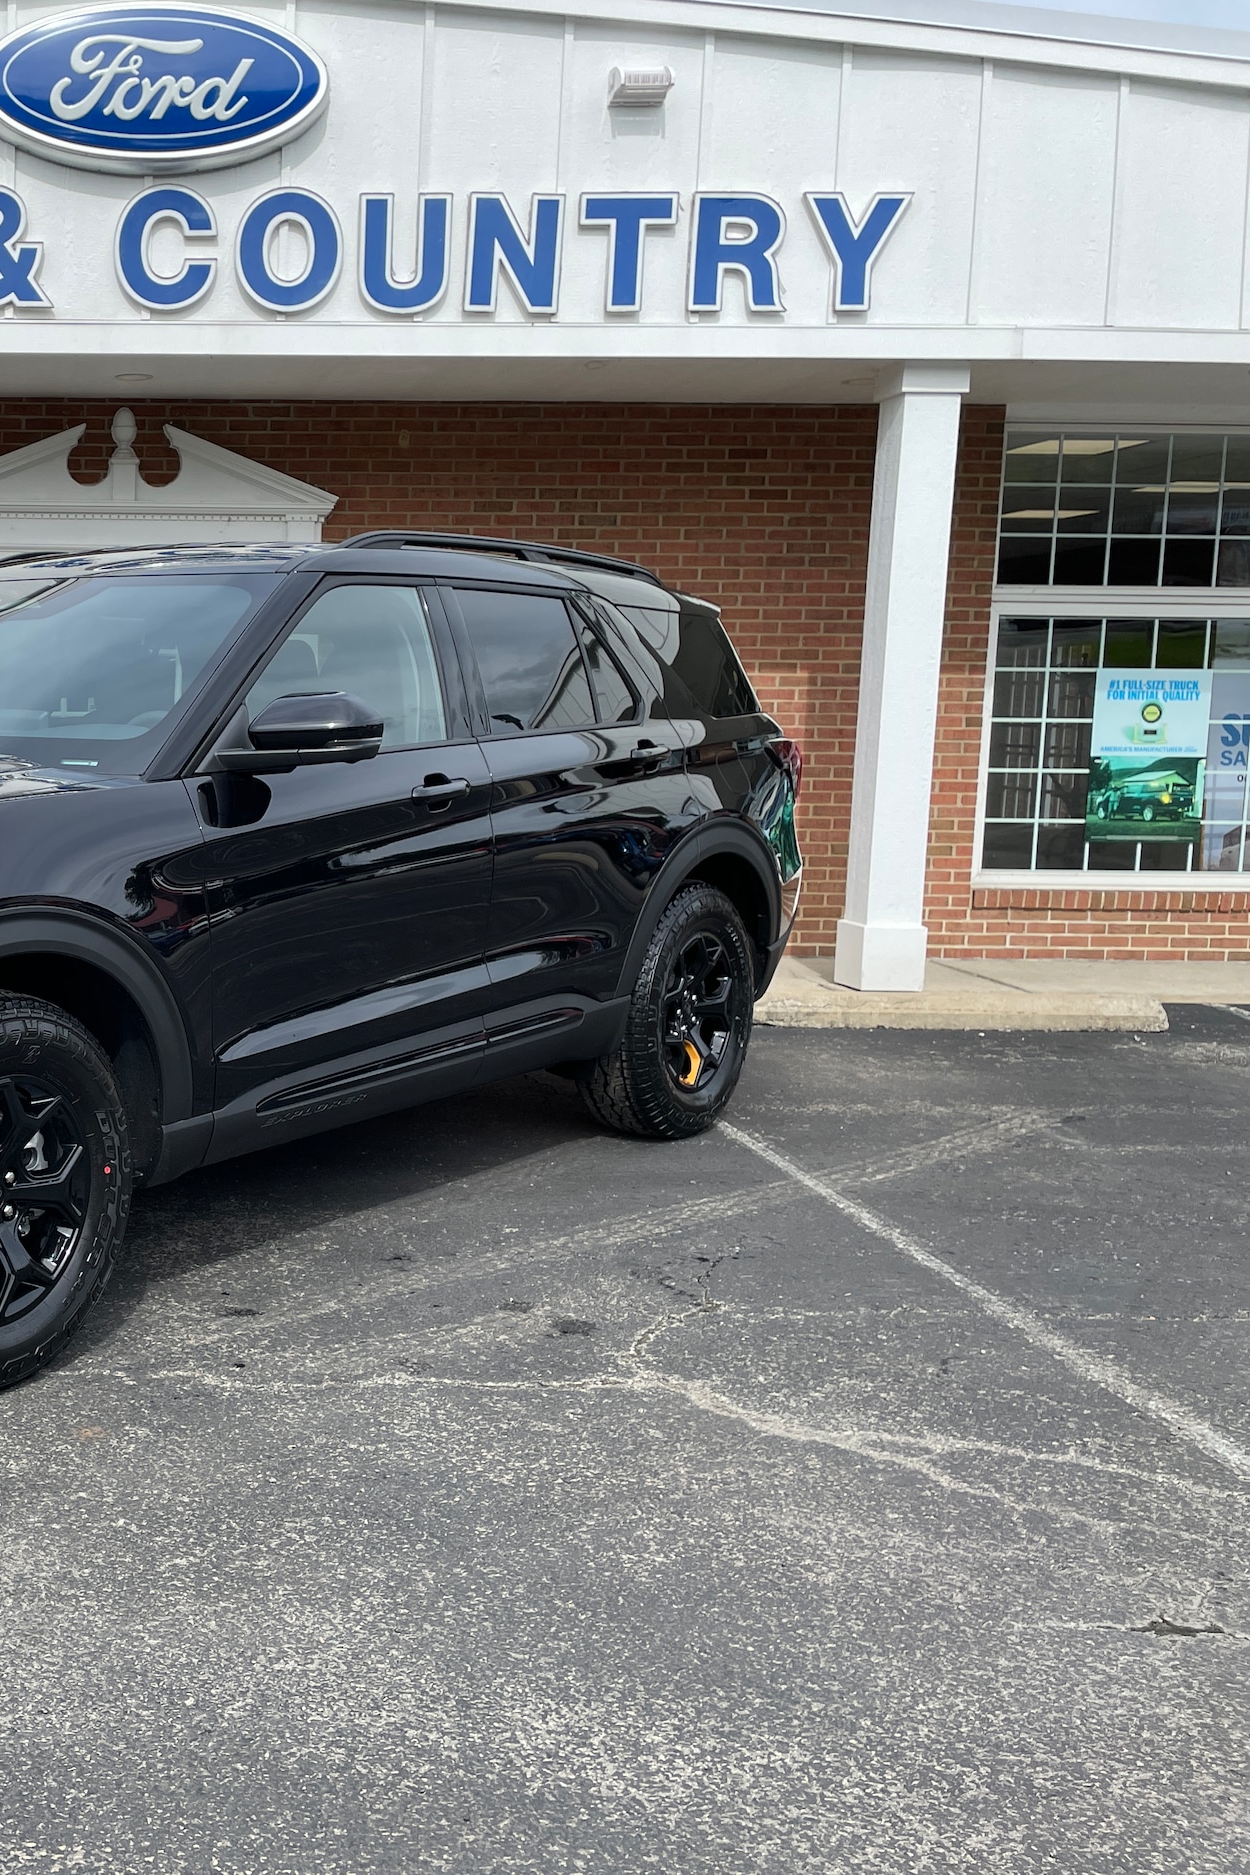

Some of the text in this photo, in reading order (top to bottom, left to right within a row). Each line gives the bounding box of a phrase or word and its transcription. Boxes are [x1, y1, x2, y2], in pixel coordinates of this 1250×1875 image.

[49, 34, 255, 121] Ford
[114, 182, 915, 314] COUNTRY
[1107, 690, 1200, 702] FOR INITIAL QUALITY
[1109, 680, 1199, 690] #1 FULL-SIZE TRUCK
